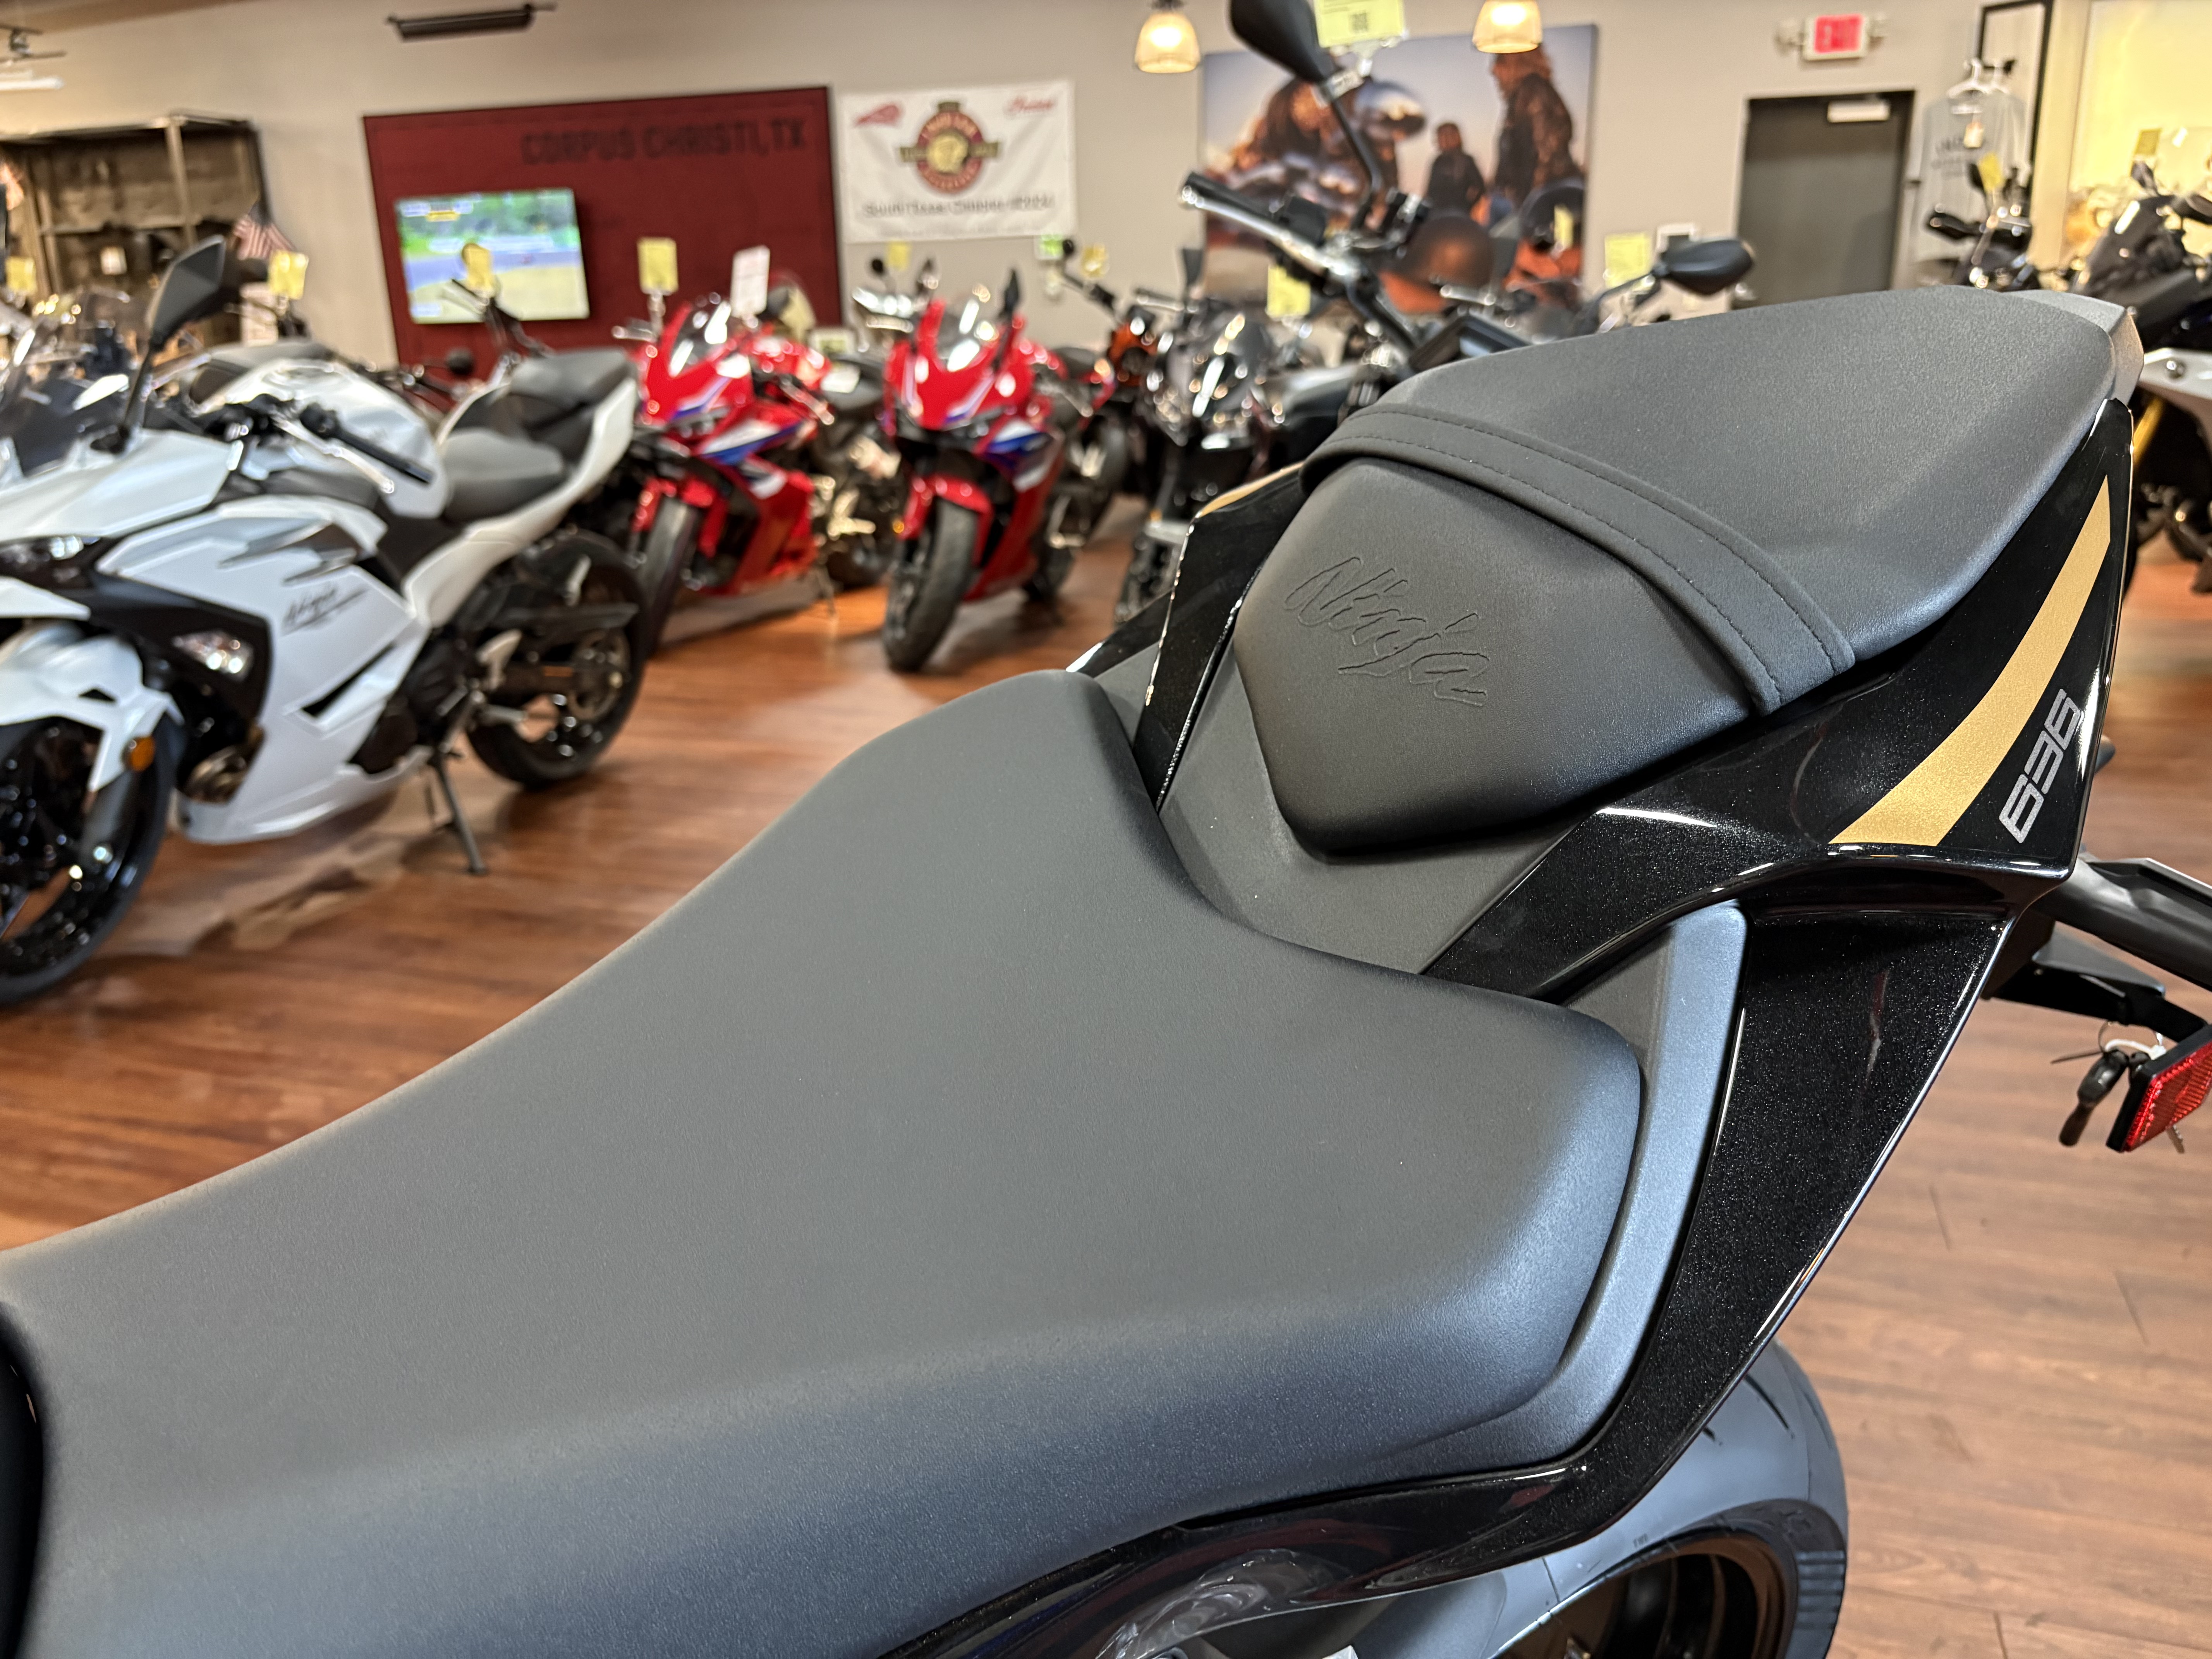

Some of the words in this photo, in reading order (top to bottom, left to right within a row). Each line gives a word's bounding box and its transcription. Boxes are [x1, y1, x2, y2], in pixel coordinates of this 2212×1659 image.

[521, 129, 636, 164] CORPUS
[1283, 556, 1491, 707] Ninja
[1999, 689, 2081, 843] 636
